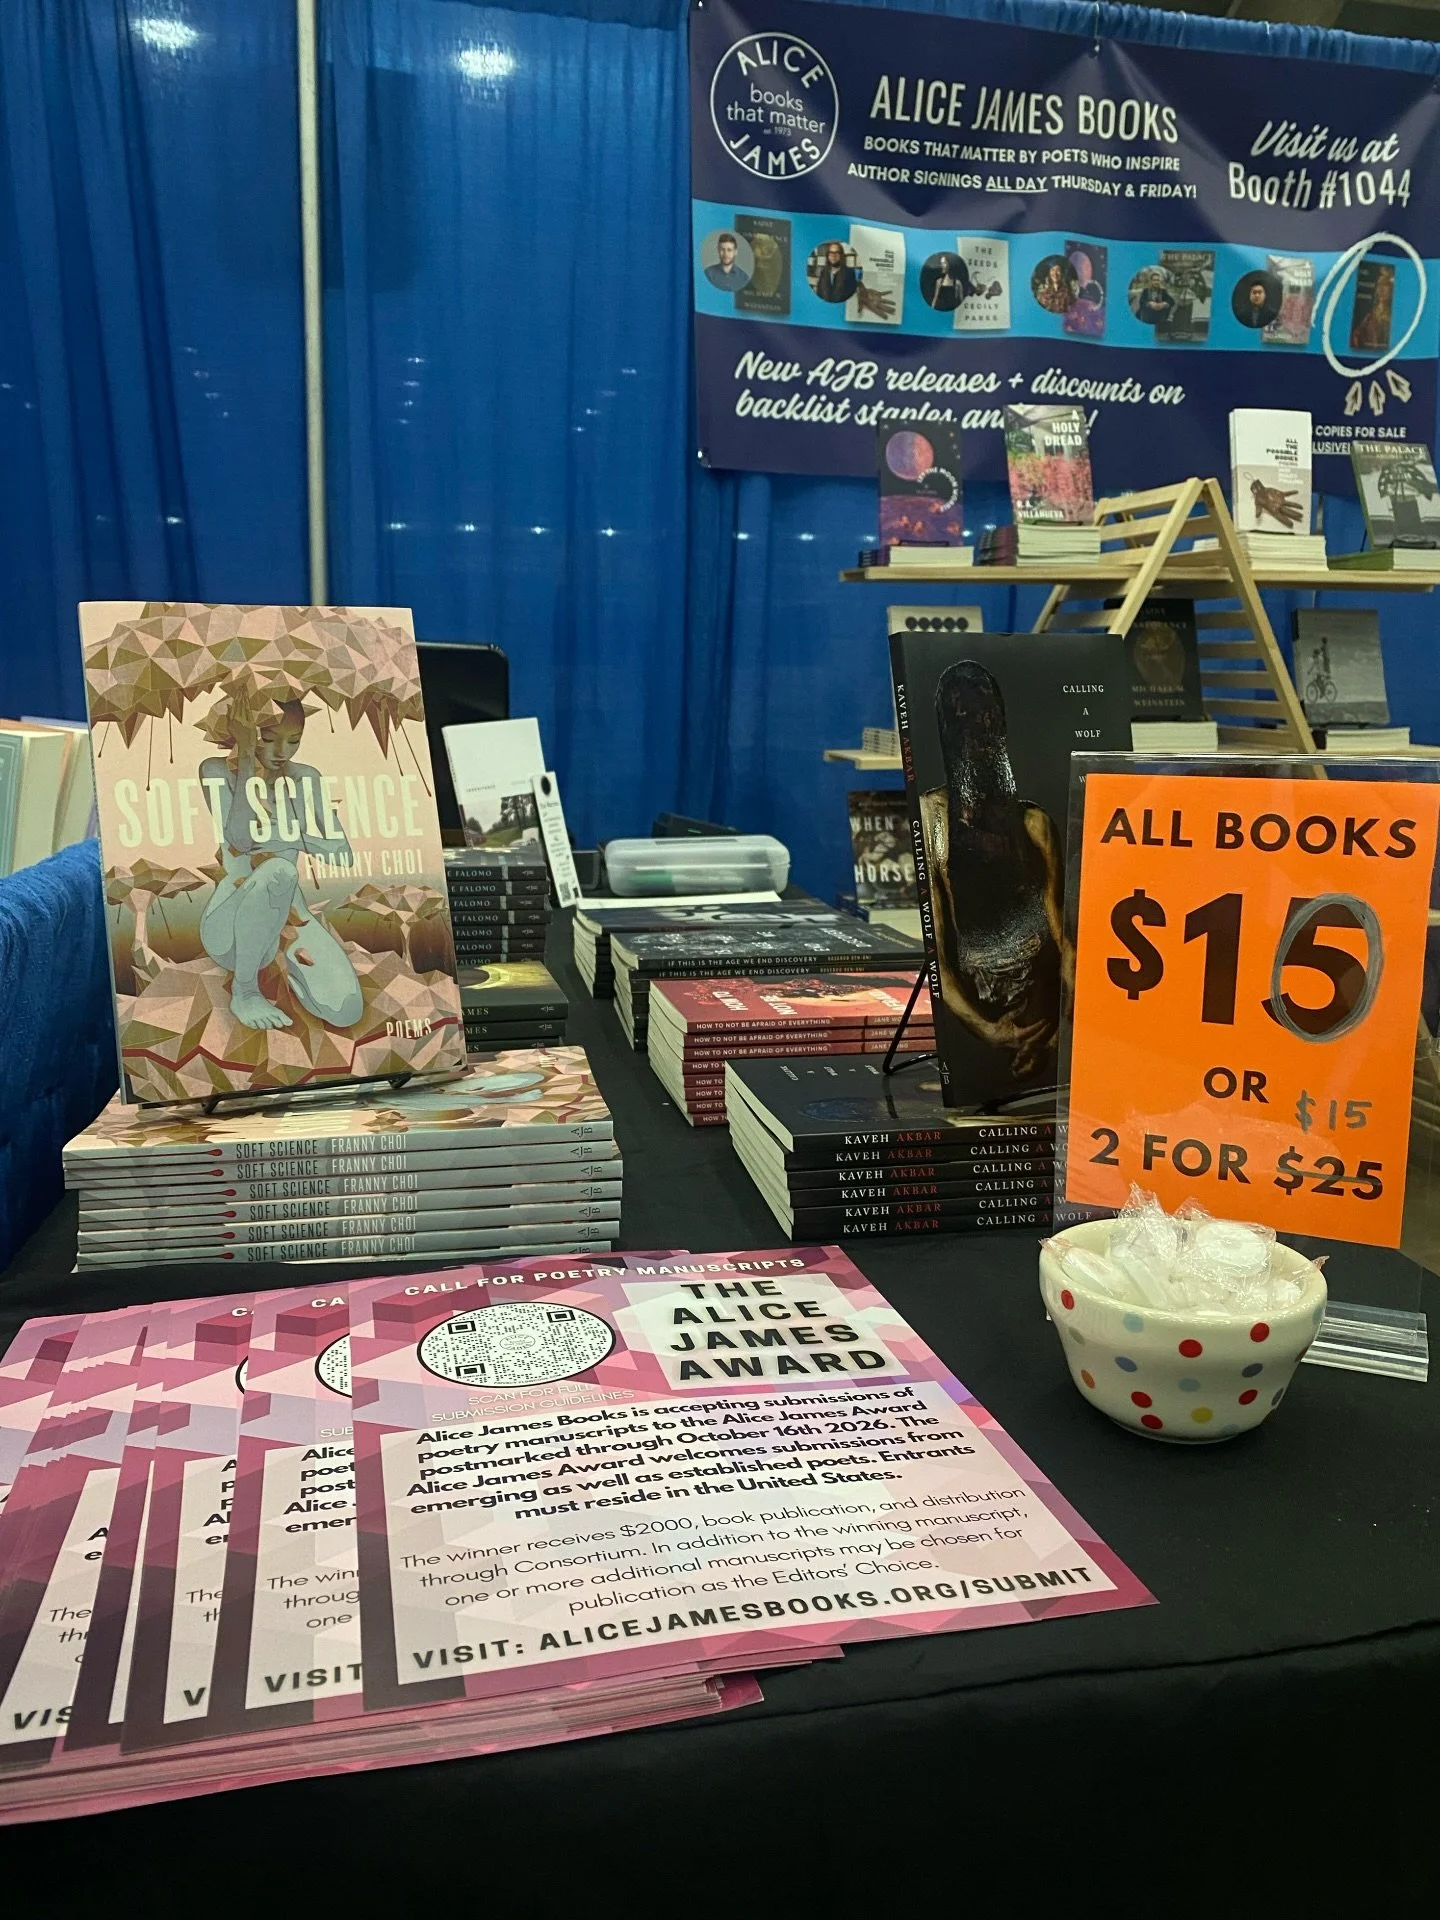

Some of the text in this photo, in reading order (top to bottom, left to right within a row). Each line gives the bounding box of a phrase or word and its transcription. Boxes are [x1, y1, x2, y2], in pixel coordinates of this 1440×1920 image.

[736, 41, 824, 89] ALICE
[750, 84, 803, 112] books
[870, 75, 1178, 143] ALICE JAMES BOOKS
[727, 102, 825, 134] that matter
[730, 134, 820, 175] JAMES
[864, 136, 1180, 171] BOOKS THAT MATTER BY POETS WHO INSPIRE
[1251, 120, 1400, 163] Visit us at
[848, 162, 1197, 199] AUTHOR SIGNINGS ALL DAY THURSDAY & FRIDAY!
[1229, 161, 1412, 209] Booth #1044
[968, 257, 998, 269] SEEDS
[975, 246, 993, 255] THE
[964, 302, 999, 312] CECILY
[964, 314, 998, 322] PARKS
[735, 350, 1185, 405] New AJB releases + discounts on
[735, 388, 851, 425] backlist
[1071, 410, 1079, 420] A
[1044, 435, 1083, 446] DREAD
[1052, 422, 1081, 433] HOLY
[1315, 425, 1407, 438] COPIES FOR SALE
[1360, 444, 1424, 455] THE PALACE
[1018, 509, 1064, 519] VILLANUEVA
[1063, 684, 1104, 693] CALLING
[1083, 708, 1089, 716] A
[1075, 730, 1101, 738] WOLF
[114, 774, 423, 849] SOFT SCIENCE
[850, 815, 894, 832] WHEN
[897, 684, 909, 730] KAVEH
[903, 736, 915, 782] AKBAR
[912, 820, 926, 881] CALLING
[922, 901, 933, 939] WOLF
[929, 960, 940, 998] WOLF
[1100, 808, 1417, 859] ALL BOOKS
[305, 849, 424, 880] FRANNY CHOI
[455, 869, 492, 878] FALOMO
[854, 864, 915, 883] HORSE
[459, 884, 496, 893] FALOMO
[677, 959, 696, 967] THIS
[743, 957, 754, 965] WE
[775, 956, 817, 964] DISCOVERY
[1107, 888, 1370, 1035] $15
[386, 1018, 433, 1039] POEMS
[788, 1018, 831, 1026] EVERYTHING
[1204, 1067, 1270, 1104] OR
[1295, 1089, 1373, 1133] $15
[236, 1134, 407, 1159] SOFT SCIENCE FRANNY CHOI
[845, 1126, 1038, 1145] KAVEH AKBAR CALLING
[1089, 1128, 1383, 1200] 2 FOR $25
[843, 1211, 1092, 1233] KAVEH AKBAR CALLING WOLF
[405, 1259, 805, 1296] CALL FOR POETRY MANUSCRIPTS
[680, 1280, 783, 1299] THE
[673, 1301, 827, 1325] ALICE
[670, 1324, 860, 1352] JAMES
[679, 1350, 886, 1381] AWARD
[432, 1390, 635, 1422] SUBMISSION GUIDELINES
[468, 1383, 593, 1405] SCAN FOR FULL
[416, 1386, 915, 1445] Alice James Books is accepting submissions of
[417, 1400, 928, 1464] poetry manuscripts to the Alice James Award
[419, 1415, 940, 1480] postmarked through October 16th 2026. The
[400, 1515, 699, 1570] The winner receives $2000,
[413, 1566, 1093, 1669] VISIT: ALICEJAMESBOOKS.ORG/SUBMIT
